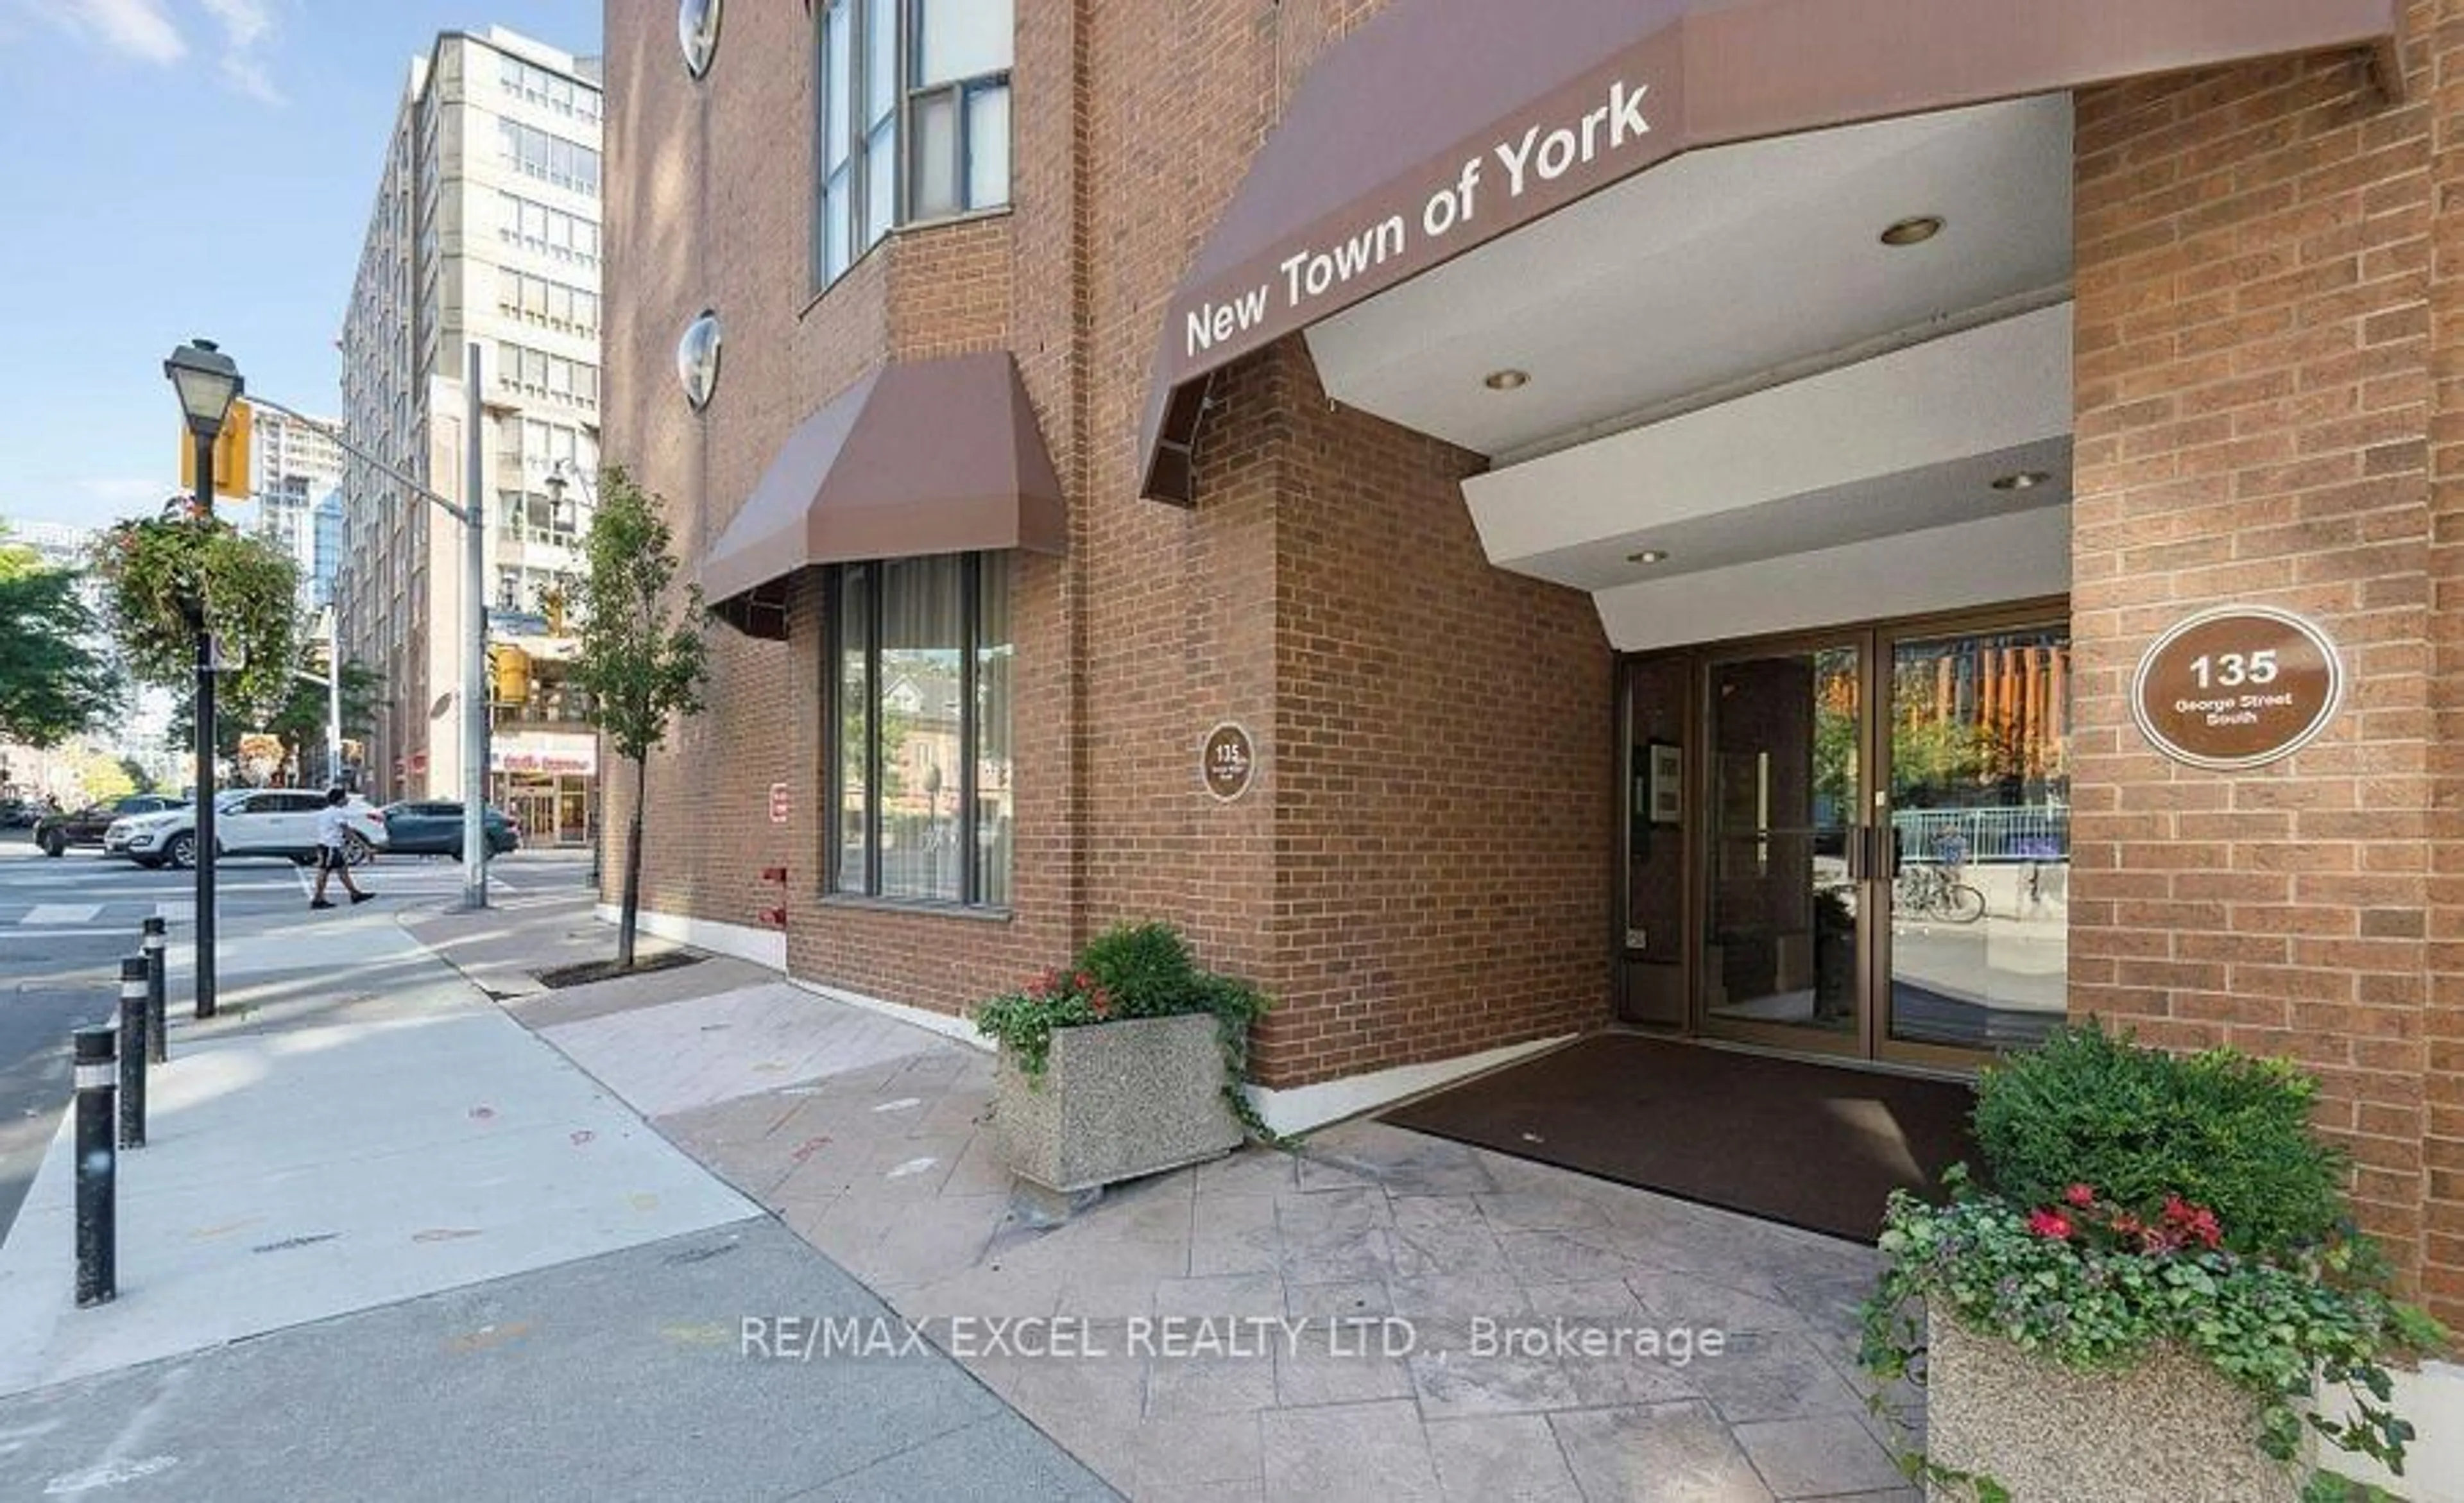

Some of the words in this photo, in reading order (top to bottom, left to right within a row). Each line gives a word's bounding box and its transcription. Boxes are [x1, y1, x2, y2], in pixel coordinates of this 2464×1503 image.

[1186, 283, 1268, 356] New
[1280, 214, 1405, 307] Town
[1423, 156, 1483, 237] of
[1494, 81, 1652, 198] York
[2190, 649, 2279, 689] 135
[2175, 698, 2236, 713] George
[2239, 692, 2293, 707] Street
[2206, 712, 2258, 726] South
